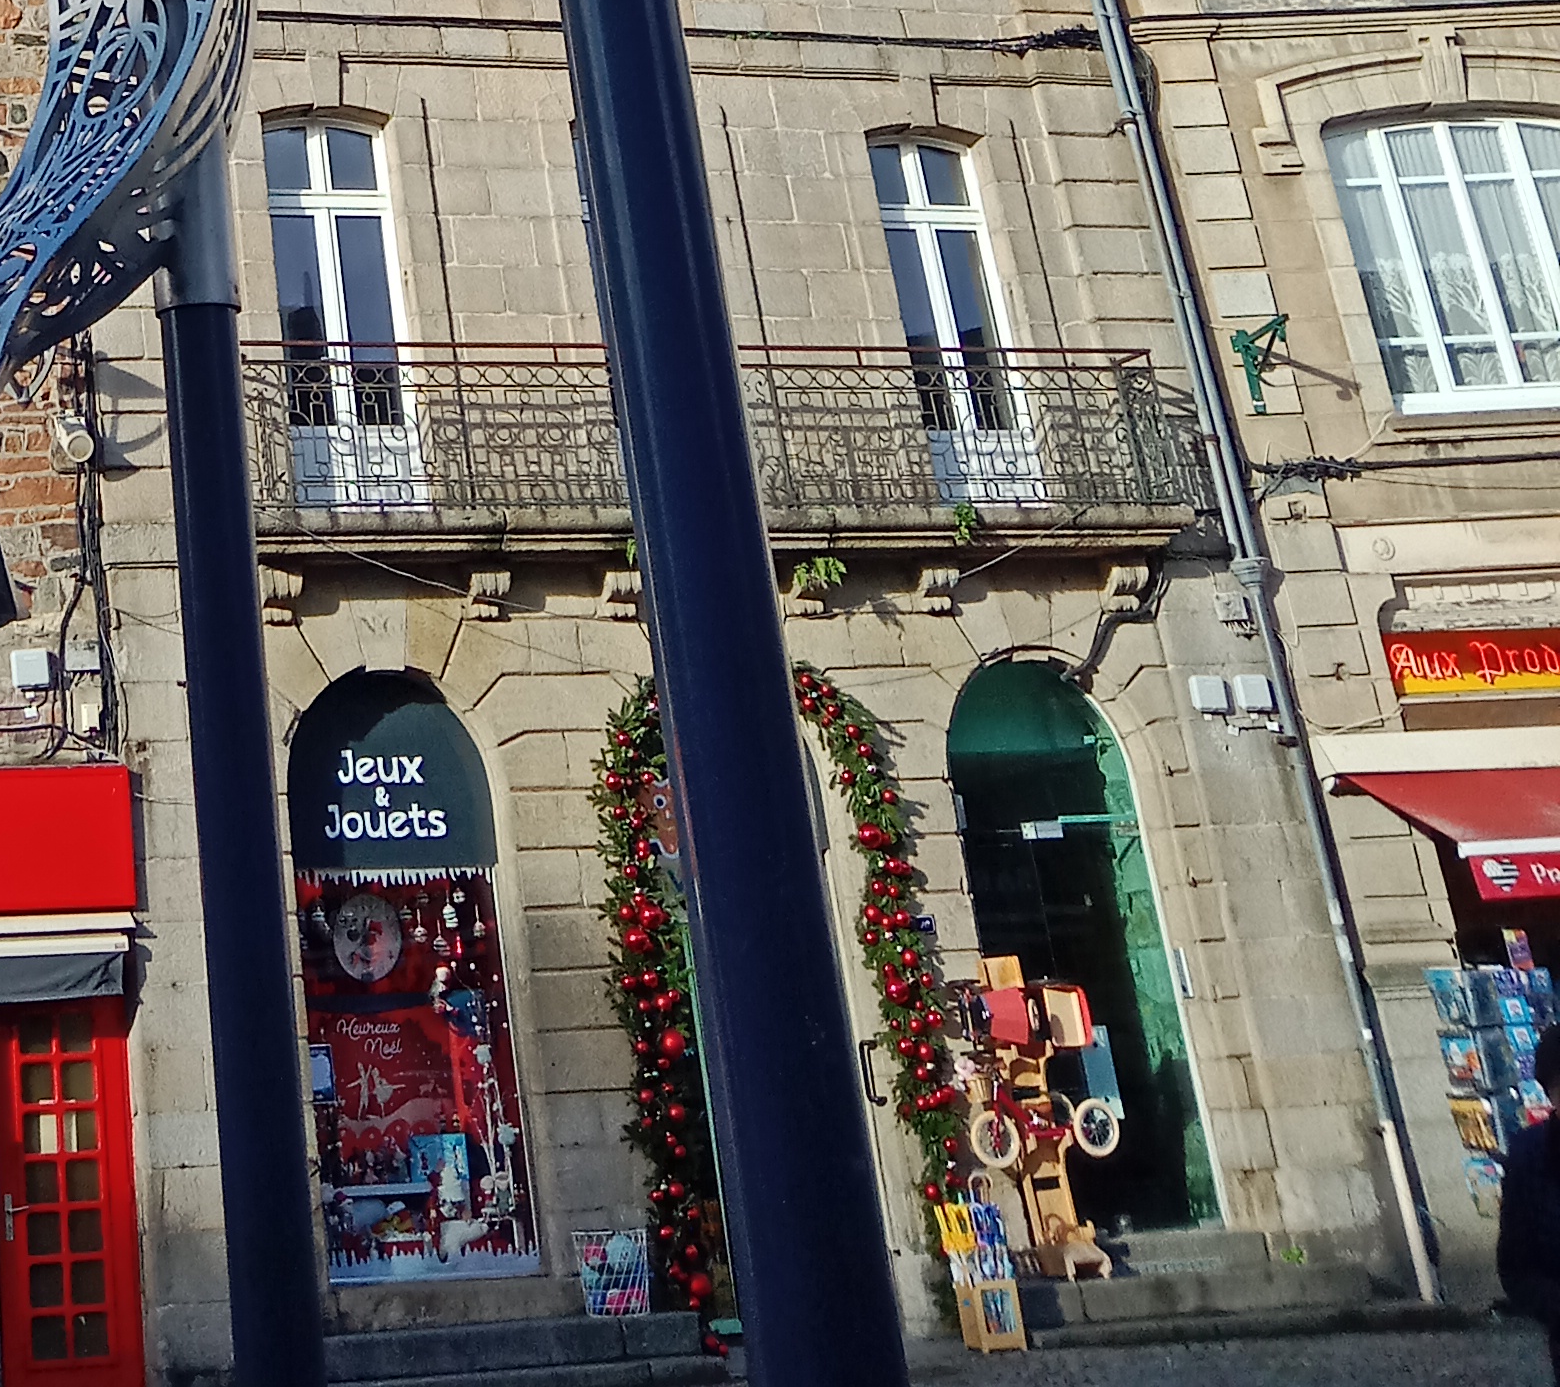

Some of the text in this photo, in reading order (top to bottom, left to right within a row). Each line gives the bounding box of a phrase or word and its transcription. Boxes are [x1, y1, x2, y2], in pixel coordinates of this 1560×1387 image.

[1390, 641, 1560, 684] Aux Prod
[337, 749, 425, 784] Jeux
[375, 786, 390, 807] &
[324, 804, 447, 839] Jouets
[336, 1017, 401, 1040] Heureux
[364, 1037, 403, 1060] Noël
